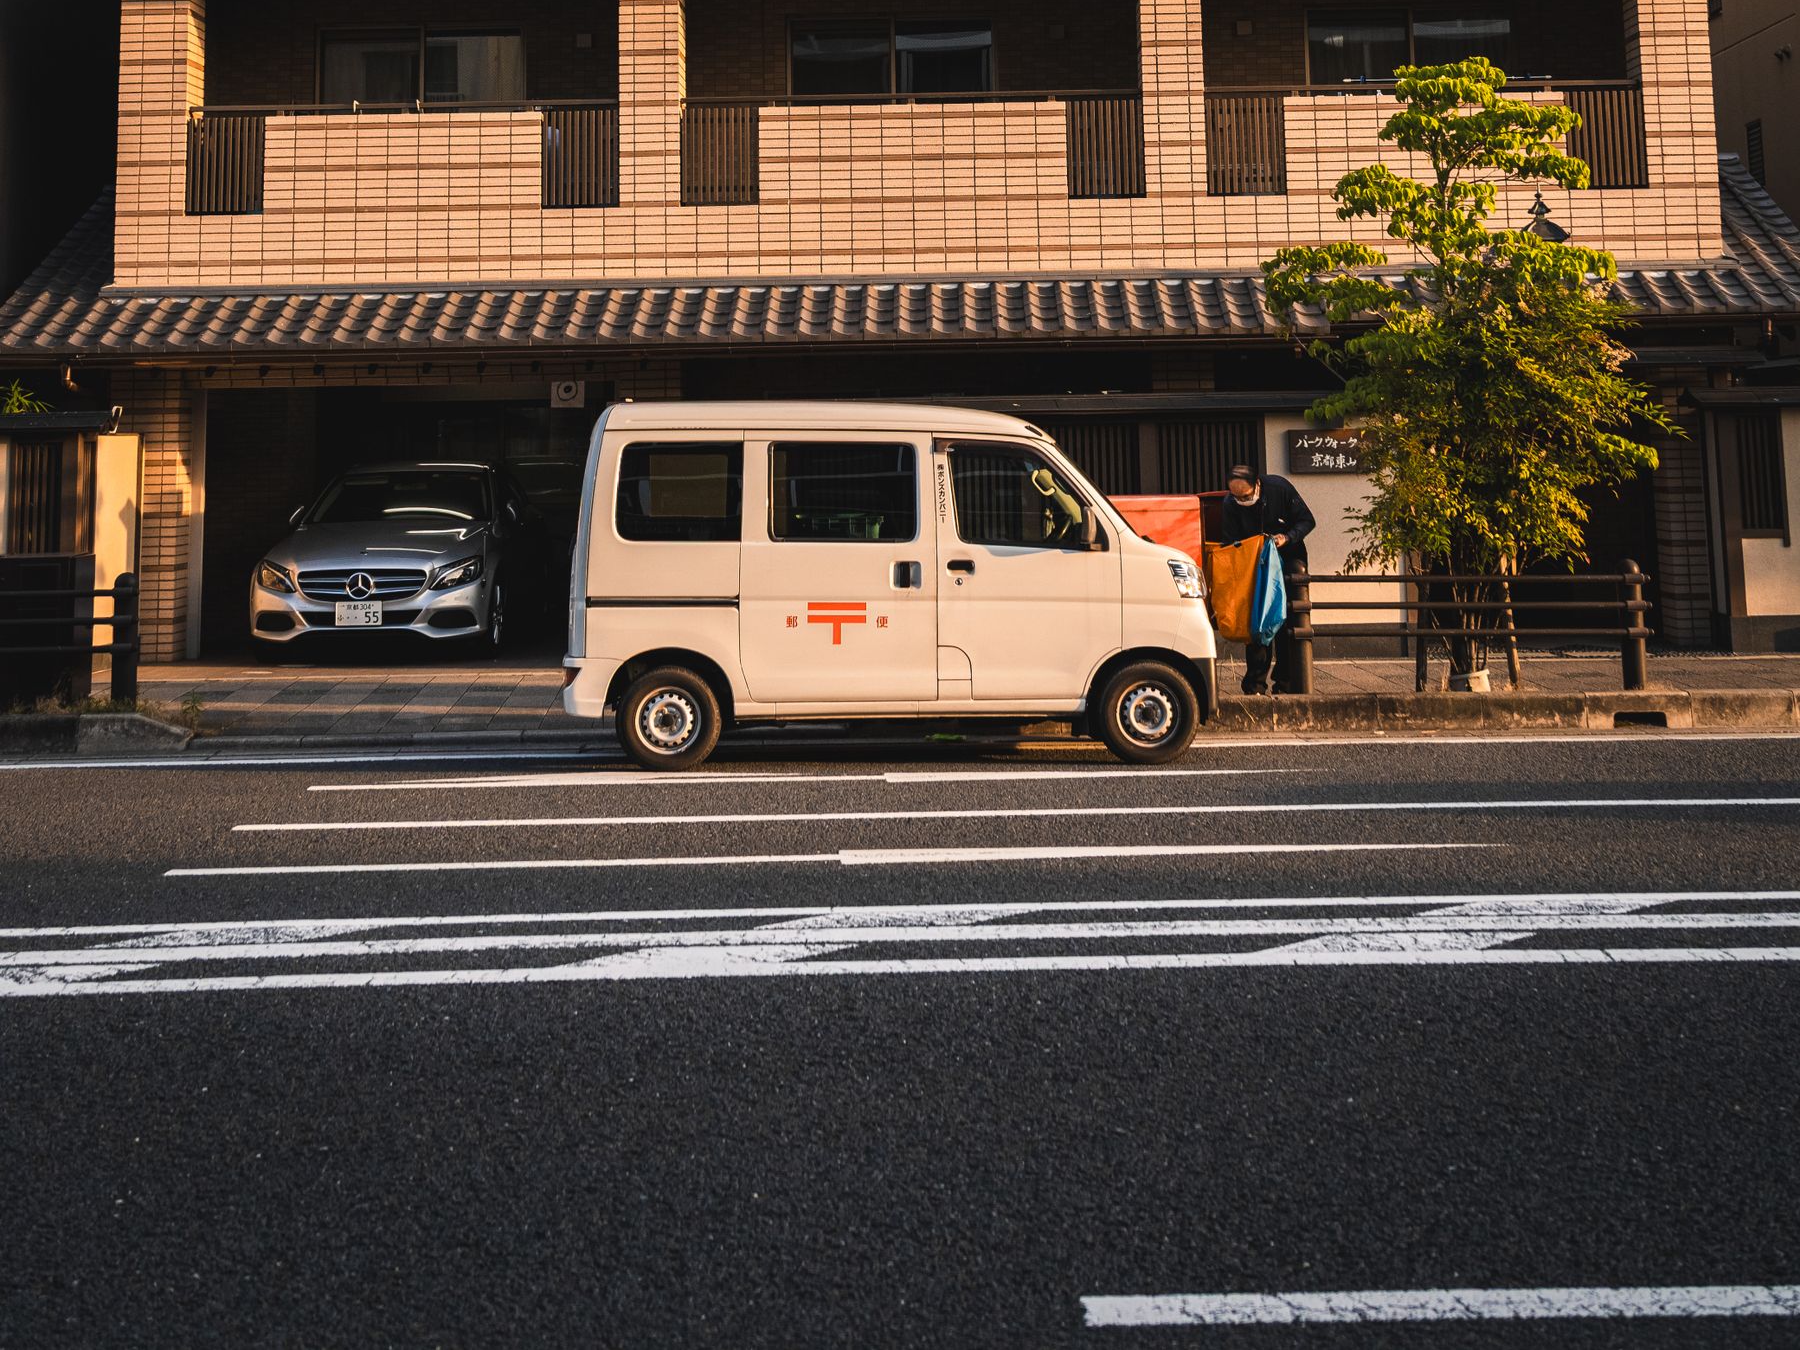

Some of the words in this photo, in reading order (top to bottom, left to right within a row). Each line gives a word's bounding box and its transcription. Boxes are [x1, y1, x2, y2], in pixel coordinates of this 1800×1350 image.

[1311, 453, 1357, 468] 京都東山
[786, 616, 798, 628] 郵
[876, 616, 888, 628] 便
